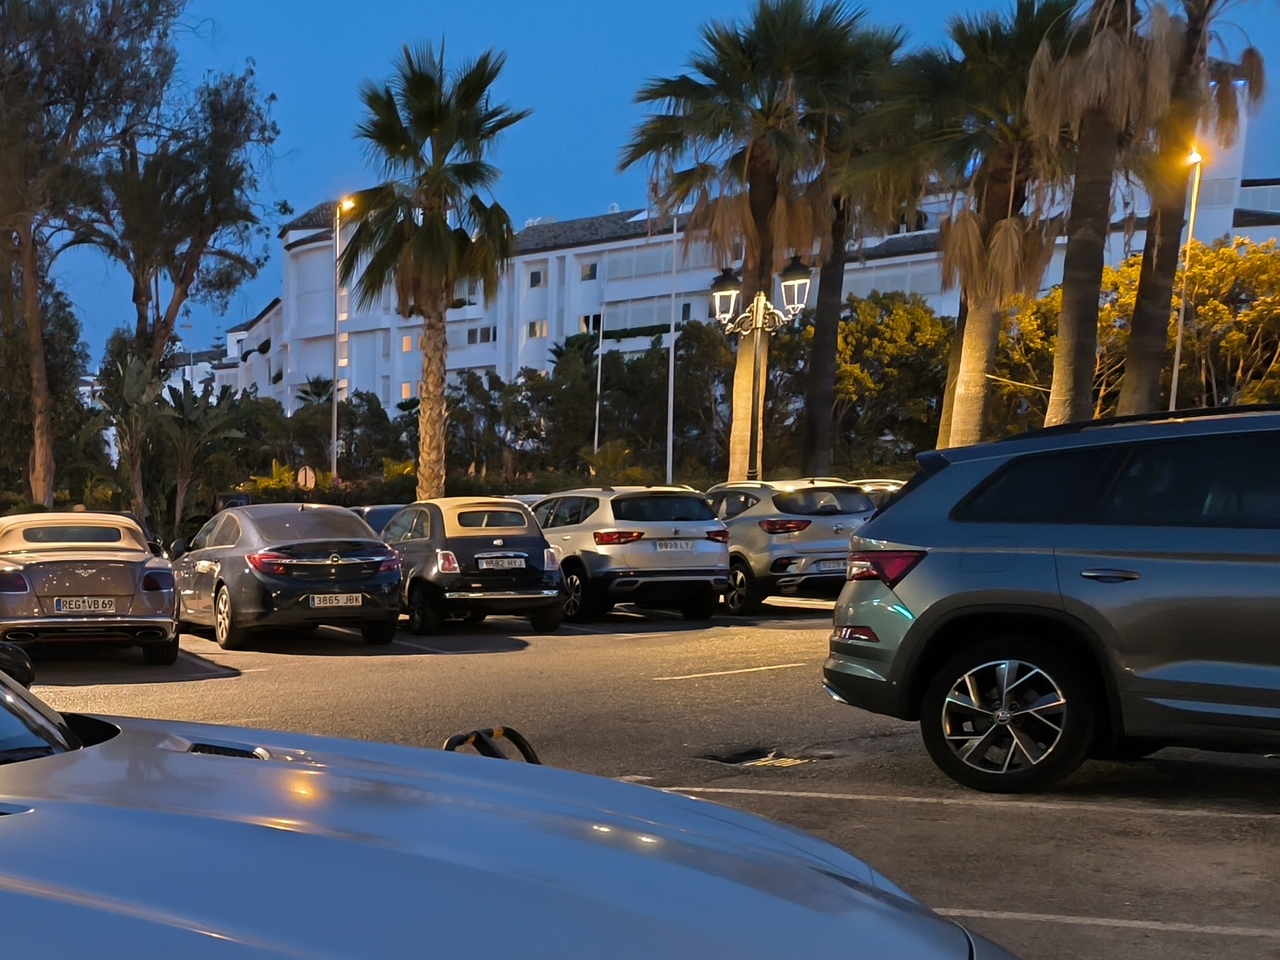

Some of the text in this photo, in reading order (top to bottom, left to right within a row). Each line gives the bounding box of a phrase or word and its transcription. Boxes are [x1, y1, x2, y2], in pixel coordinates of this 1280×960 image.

[62, 600, 113, 609] REG VB 69
[316, 596, 340, 605] 3865
